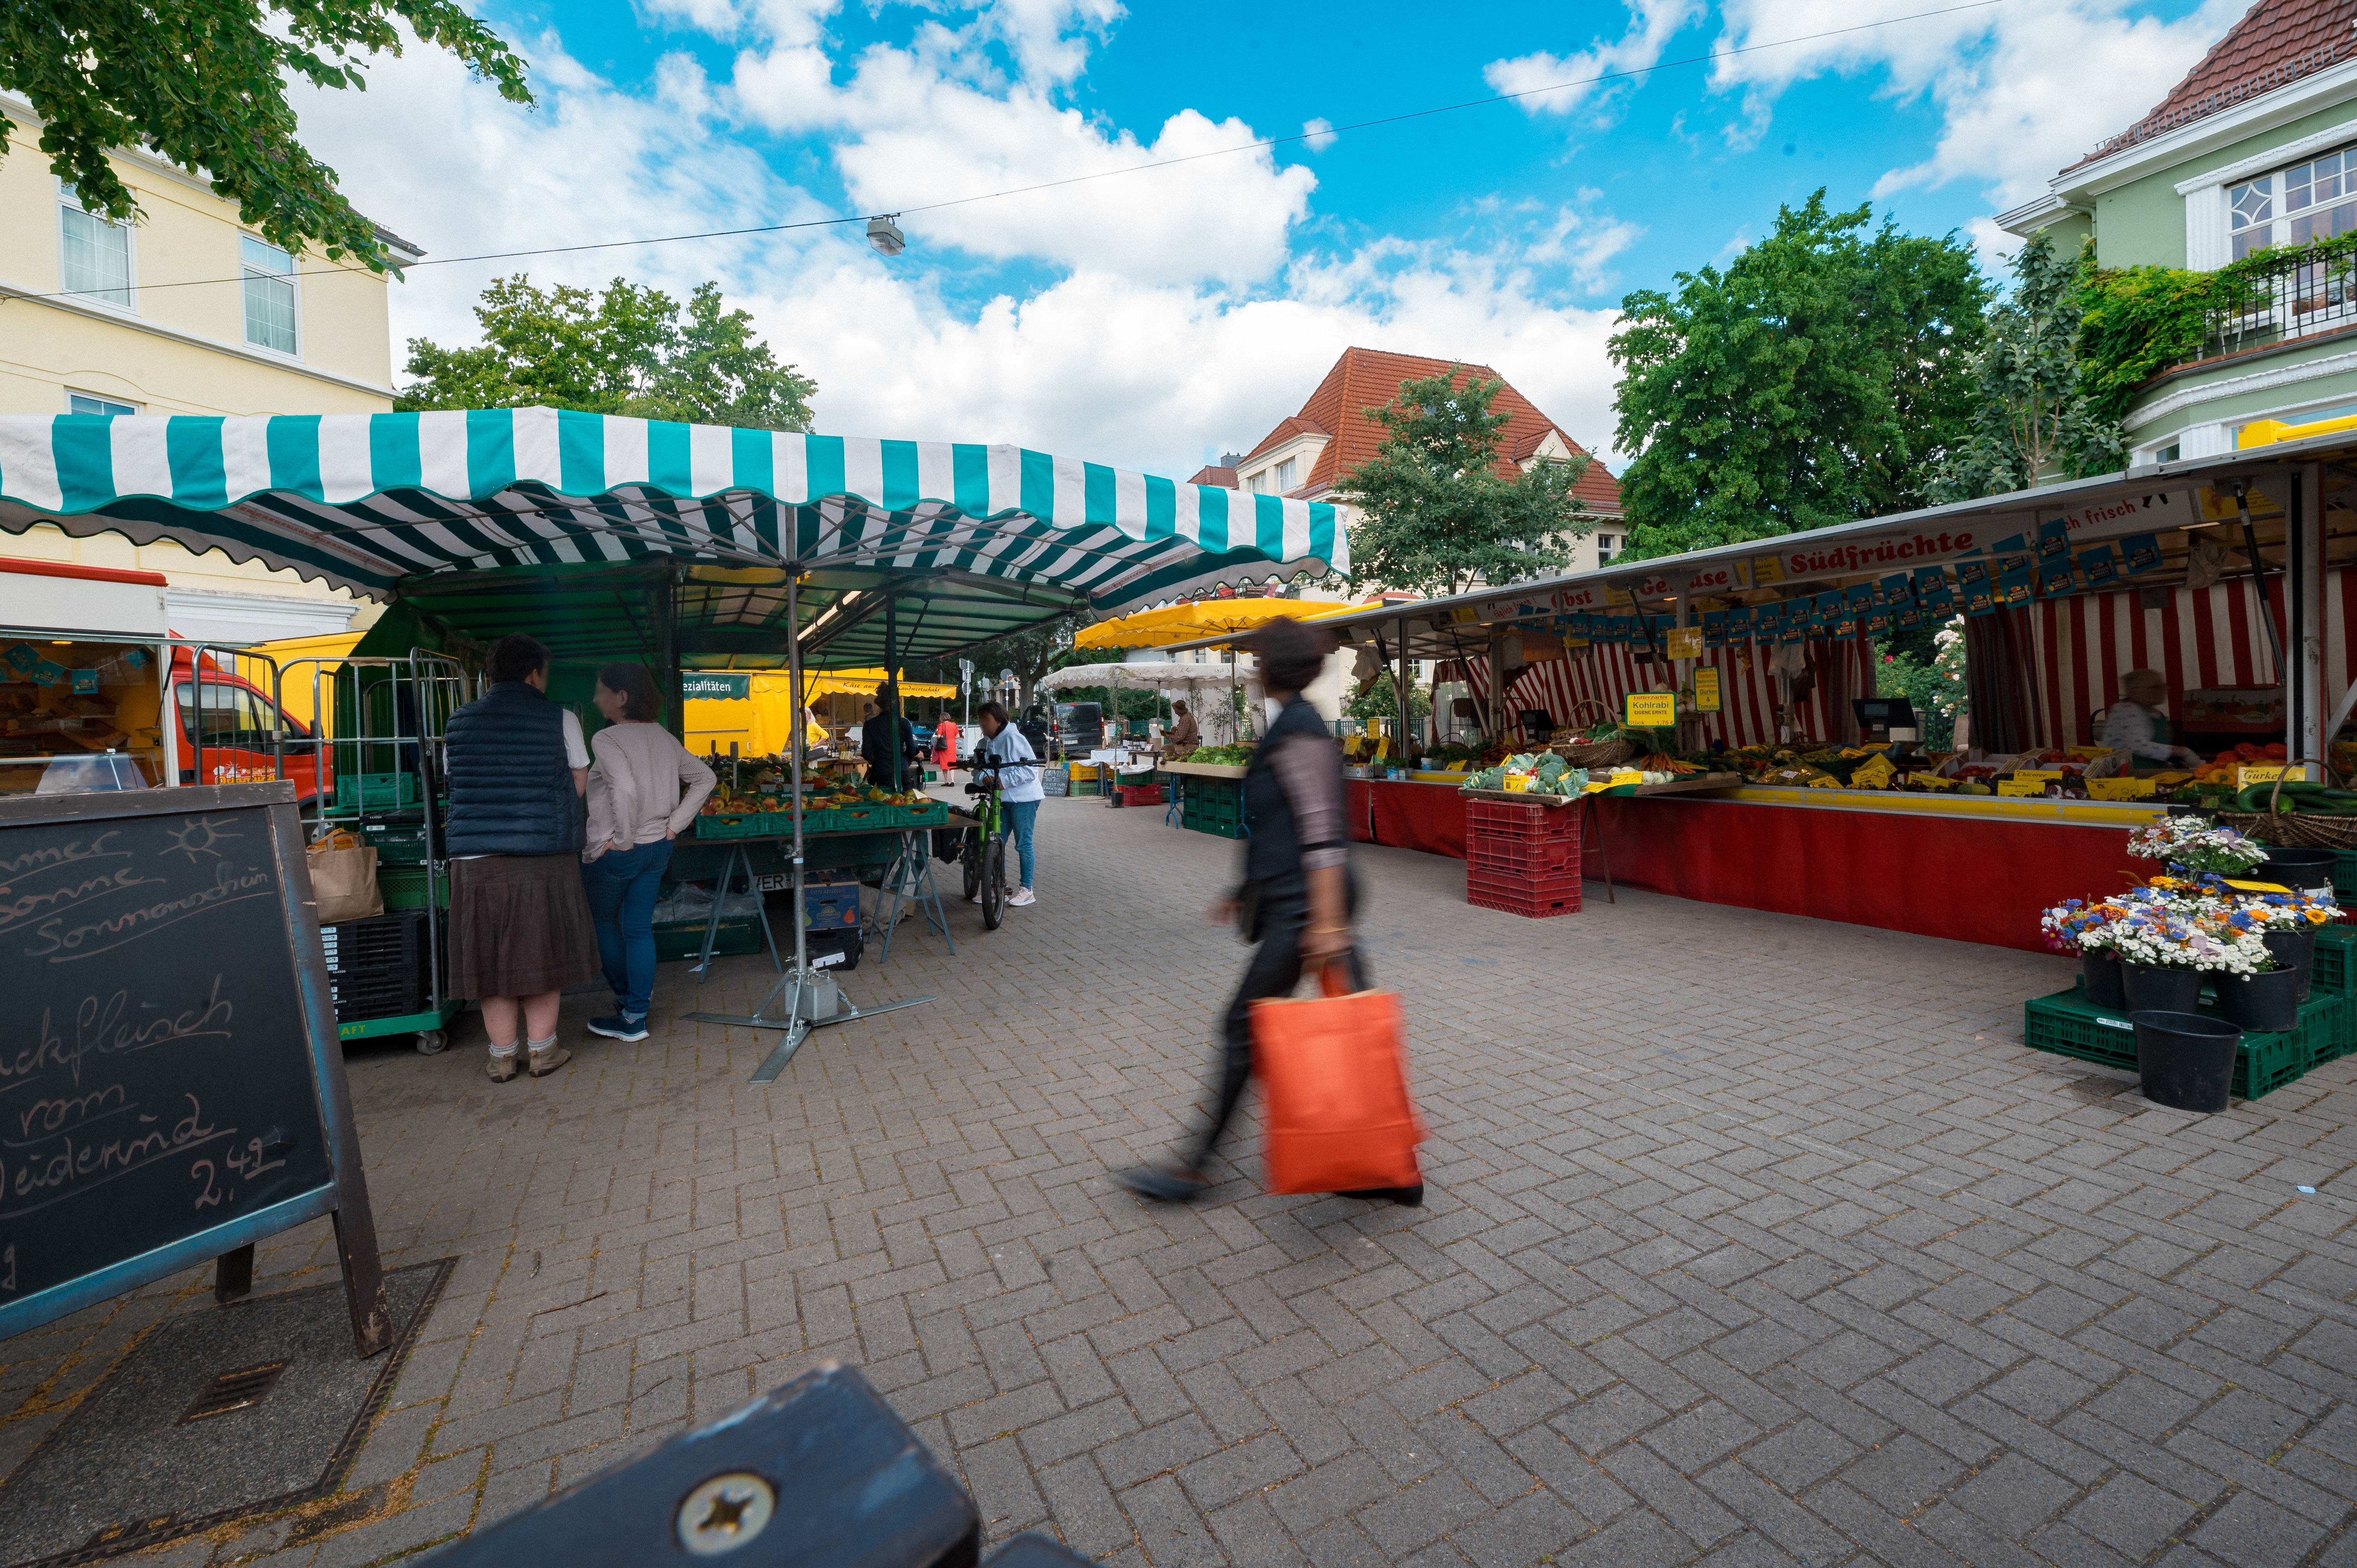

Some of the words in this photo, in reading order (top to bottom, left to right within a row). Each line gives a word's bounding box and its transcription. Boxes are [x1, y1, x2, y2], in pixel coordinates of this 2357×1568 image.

[2085, 500, 2136, 524] frisch
[1790, 532, 1973, 574] Südfrüchte
[1639, 571, 1728, 595] Gese
[1493, 604, 1514, 618] täglich
[341, 1025, 366, 1036] AFT
